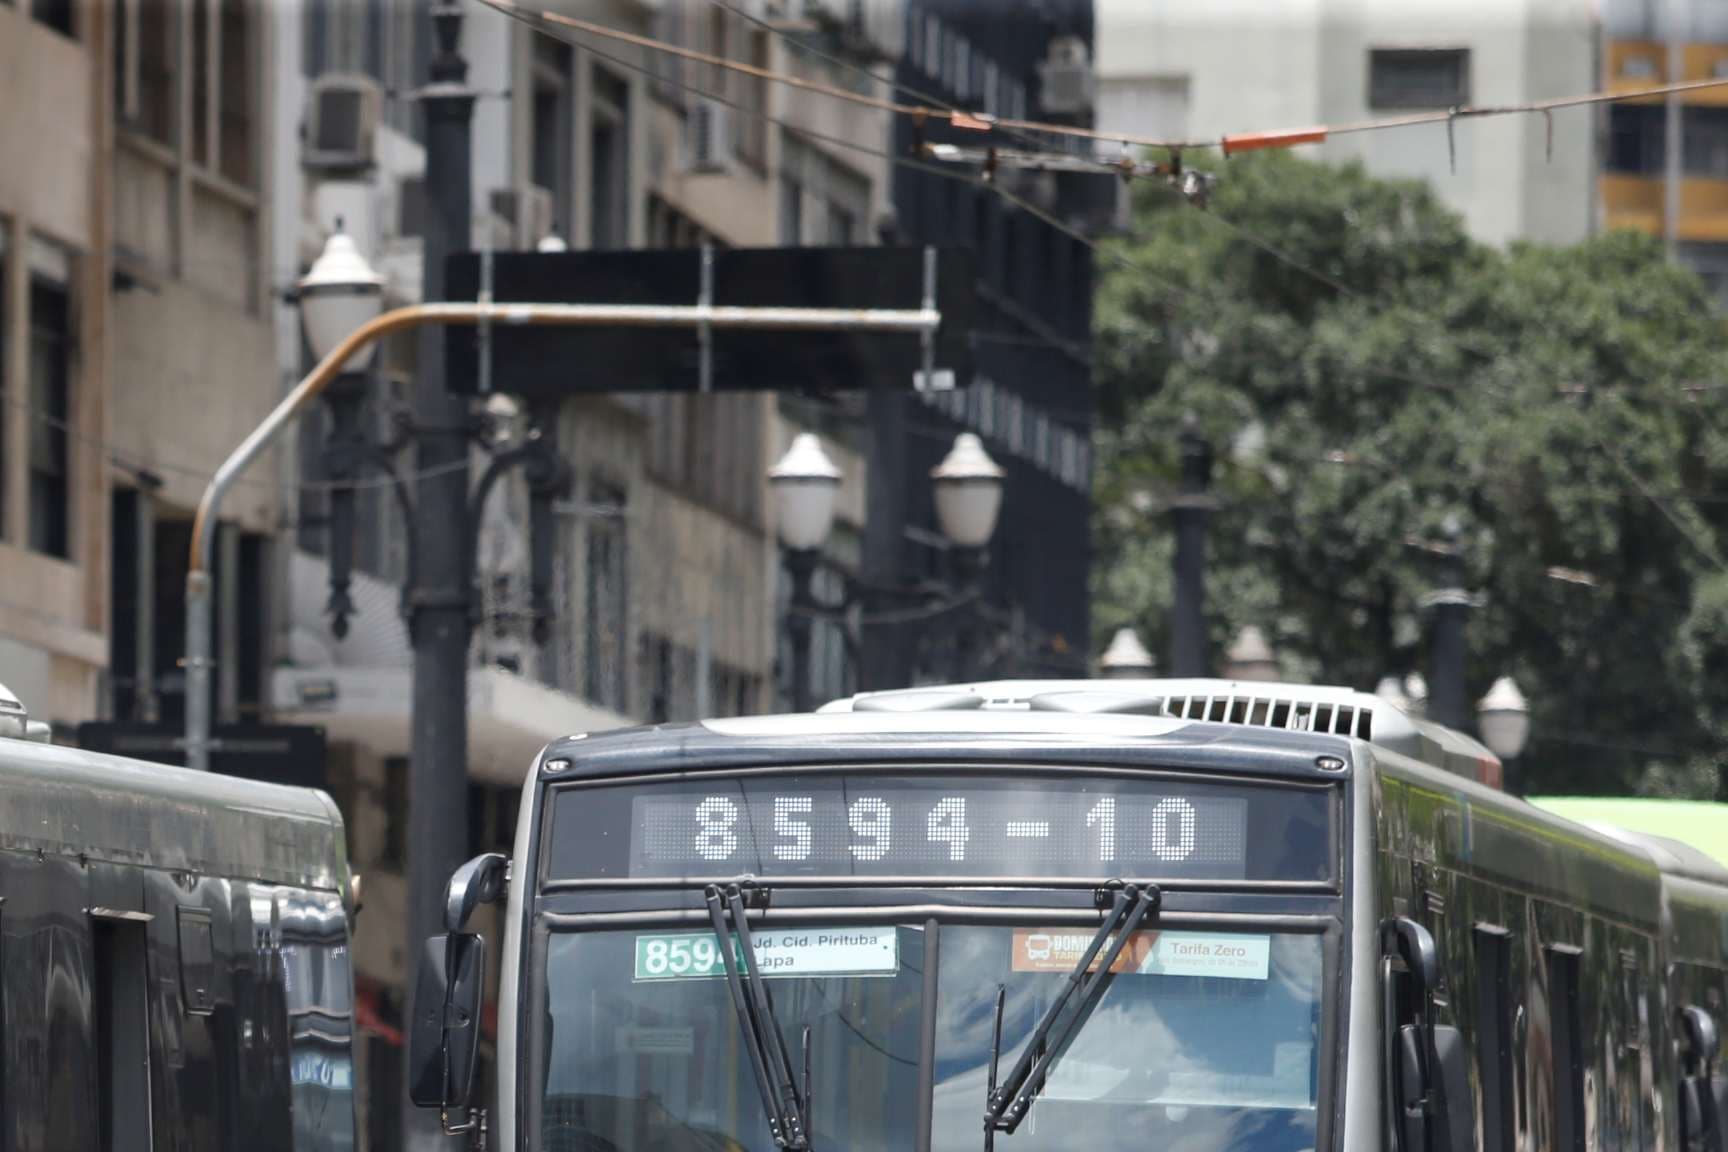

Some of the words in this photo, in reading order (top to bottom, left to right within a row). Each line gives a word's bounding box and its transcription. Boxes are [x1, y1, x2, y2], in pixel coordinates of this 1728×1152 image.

[753, 936, 776, 949] Jd.
[782, 935, 813, 948] Cid.
[818, 933, 878, 947] Pirituba
[1170, 943, 1210, 955] Tarifa
[1215, 944, 1247, 957] Zero
